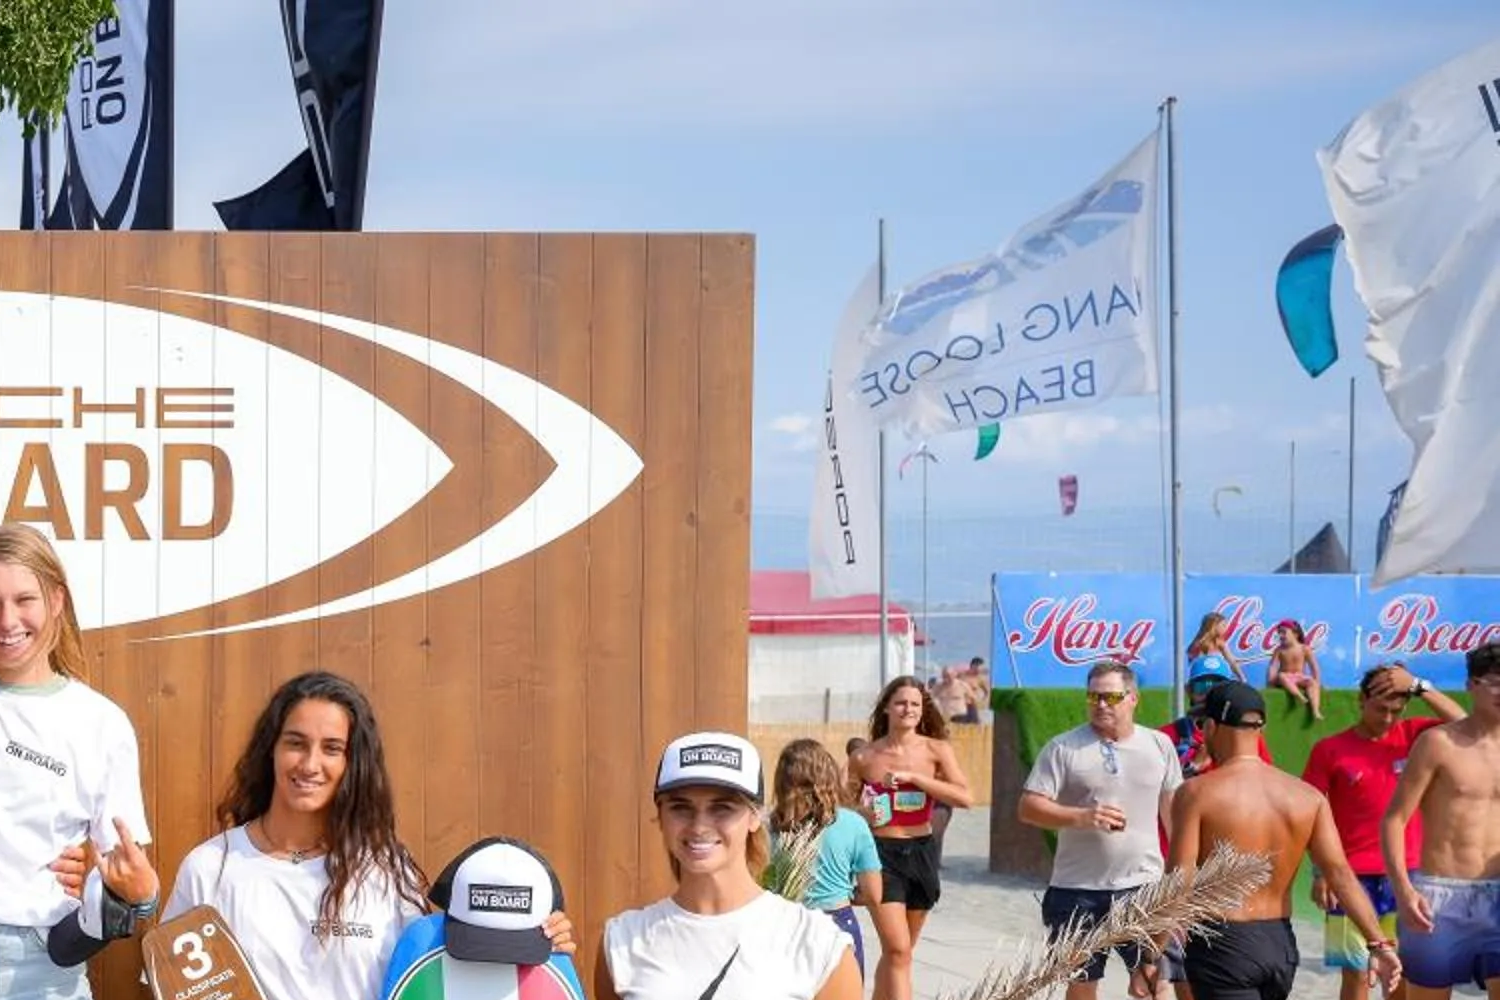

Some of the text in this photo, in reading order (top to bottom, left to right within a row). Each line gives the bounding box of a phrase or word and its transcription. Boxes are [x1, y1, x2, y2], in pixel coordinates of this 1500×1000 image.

[96, 55, 126, 125] ON
[1009, 594, 1155, 666] Hang
[471, 895, 529, 909] ON BOARD
